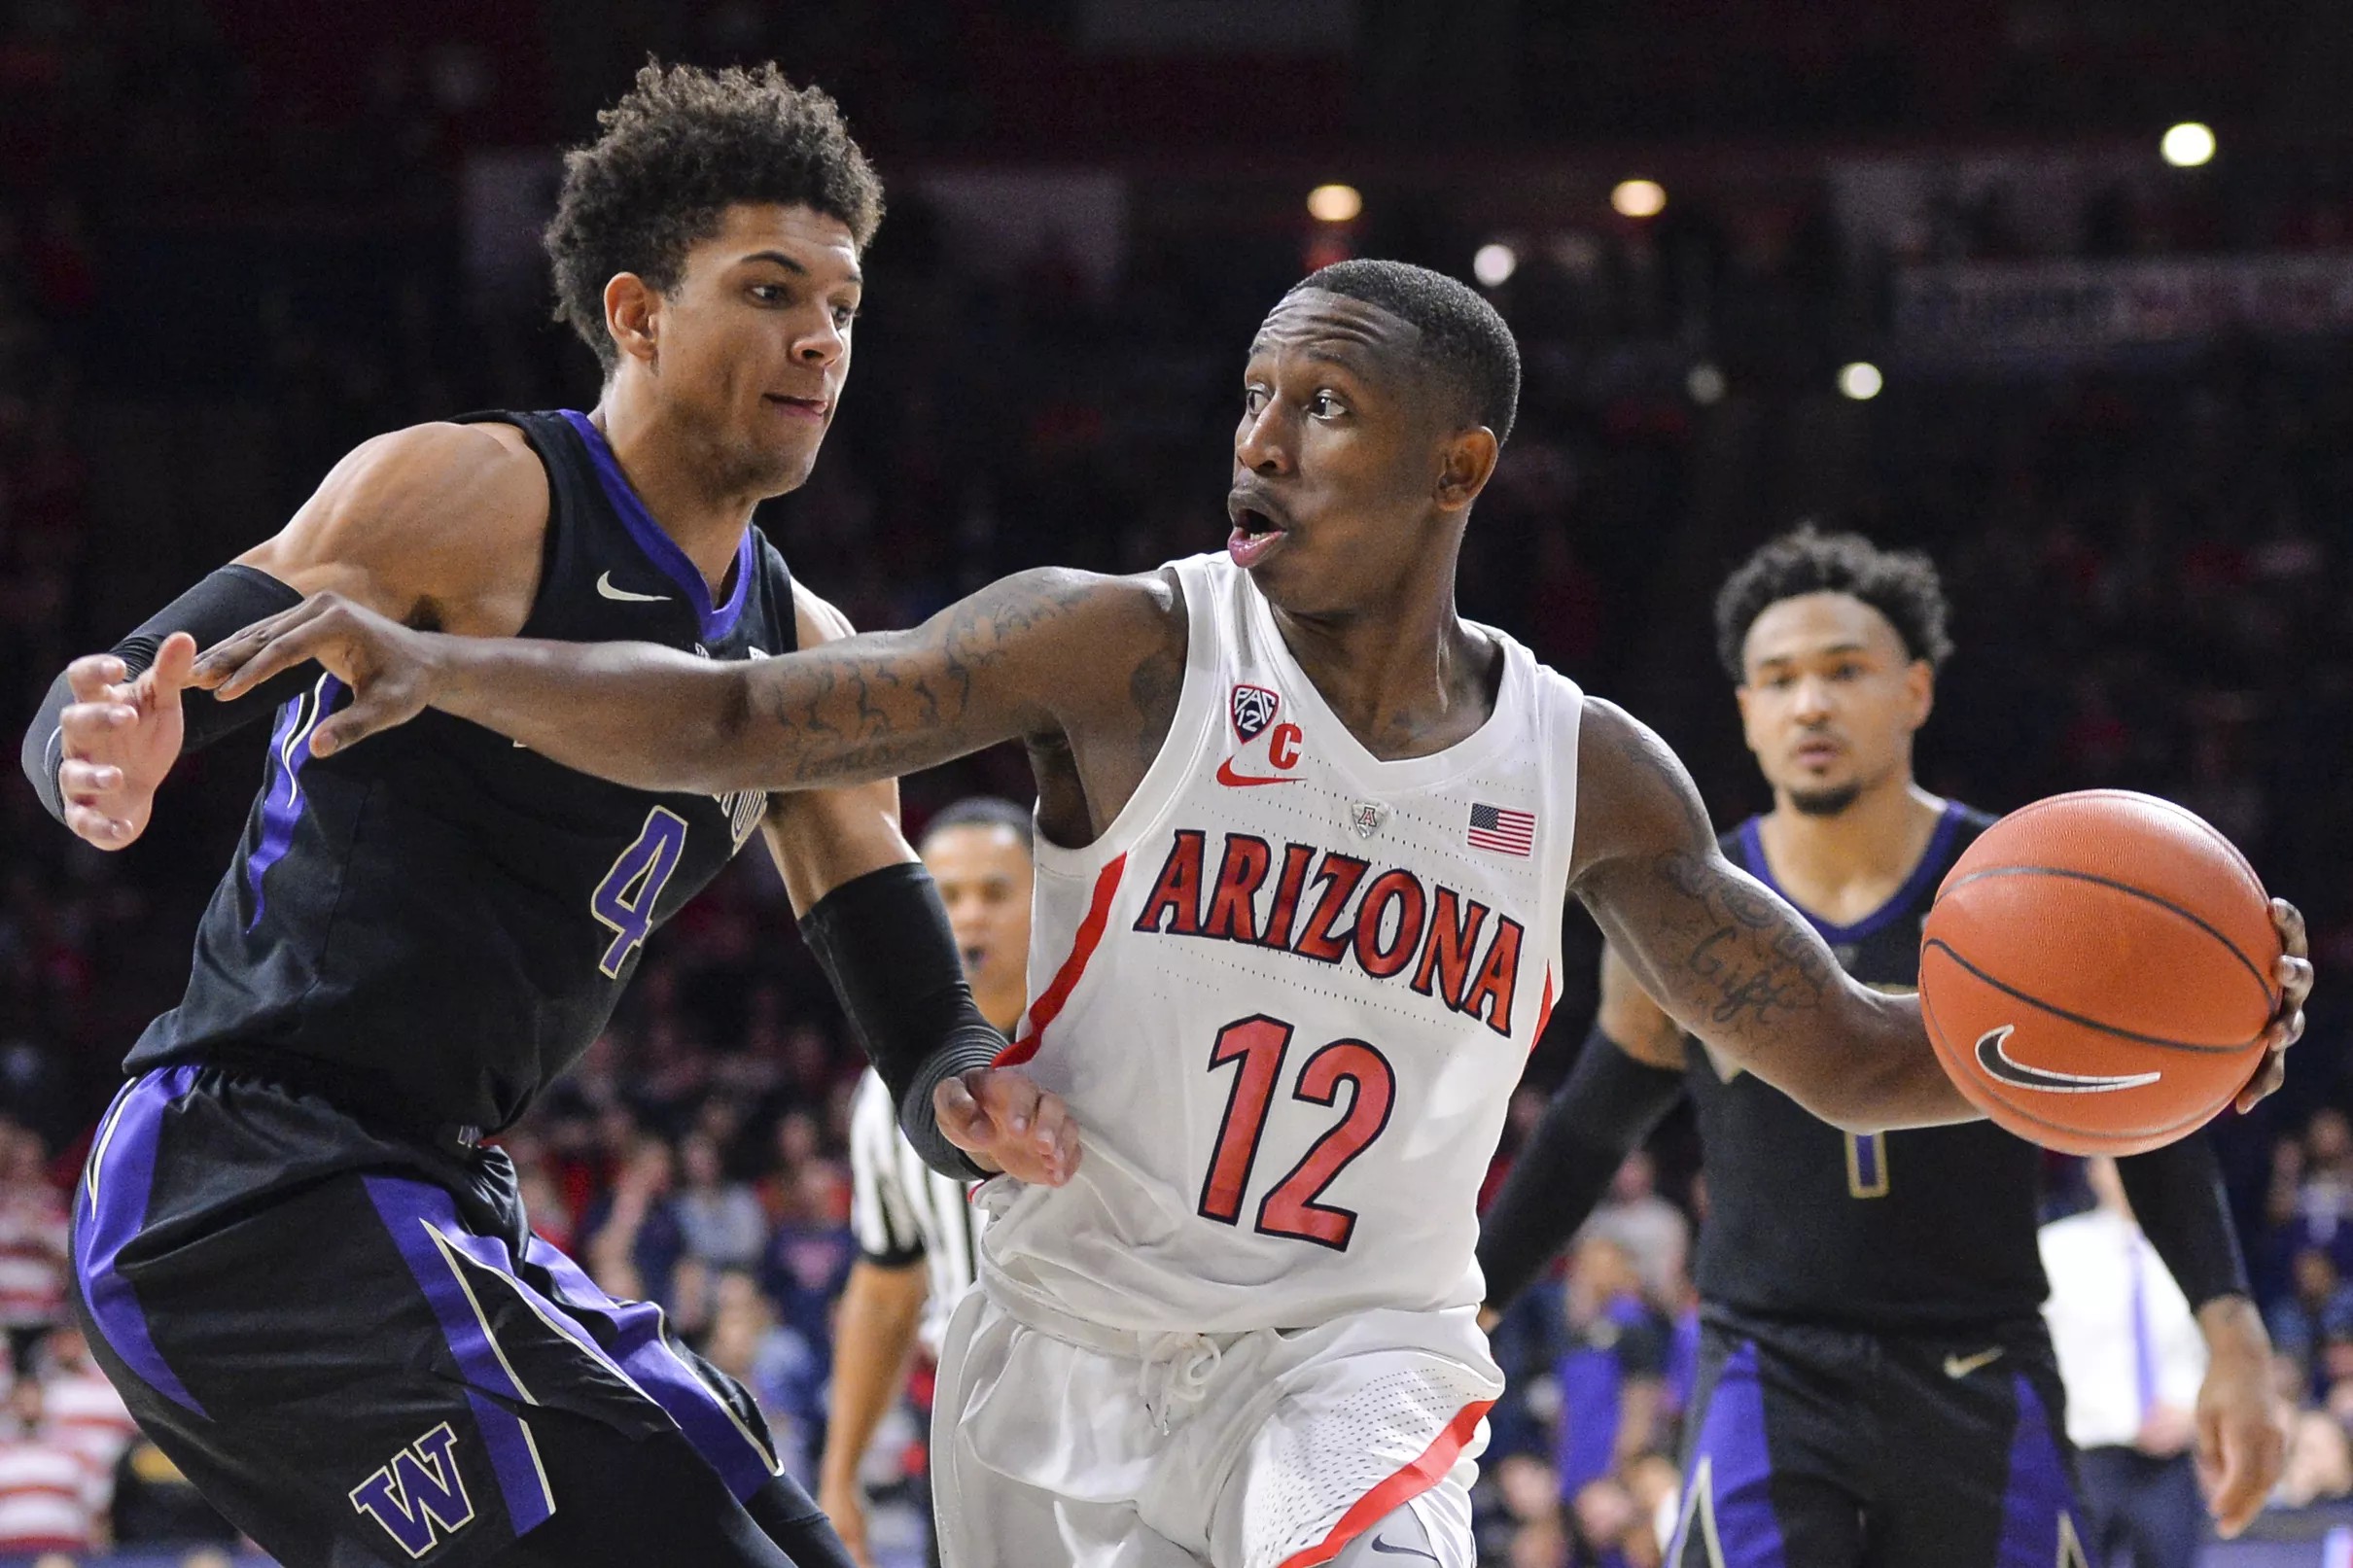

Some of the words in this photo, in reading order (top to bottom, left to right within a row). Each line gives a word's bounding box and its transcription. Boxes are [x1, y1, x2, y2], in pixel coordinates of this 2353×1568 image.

[1234, 687, 1277, 725] PAC
[1236, 709, 1261, 733] 12
[1268, 722, 1303, 771] C
[1357, 806, 1378, 828] A
[590, 804, 689, 980] 4
[1132, 828, 1526, 1038] ARIZONA
[1197, 1012, 1397, 1253] 12
[348, 1425, 475, 1560] W
